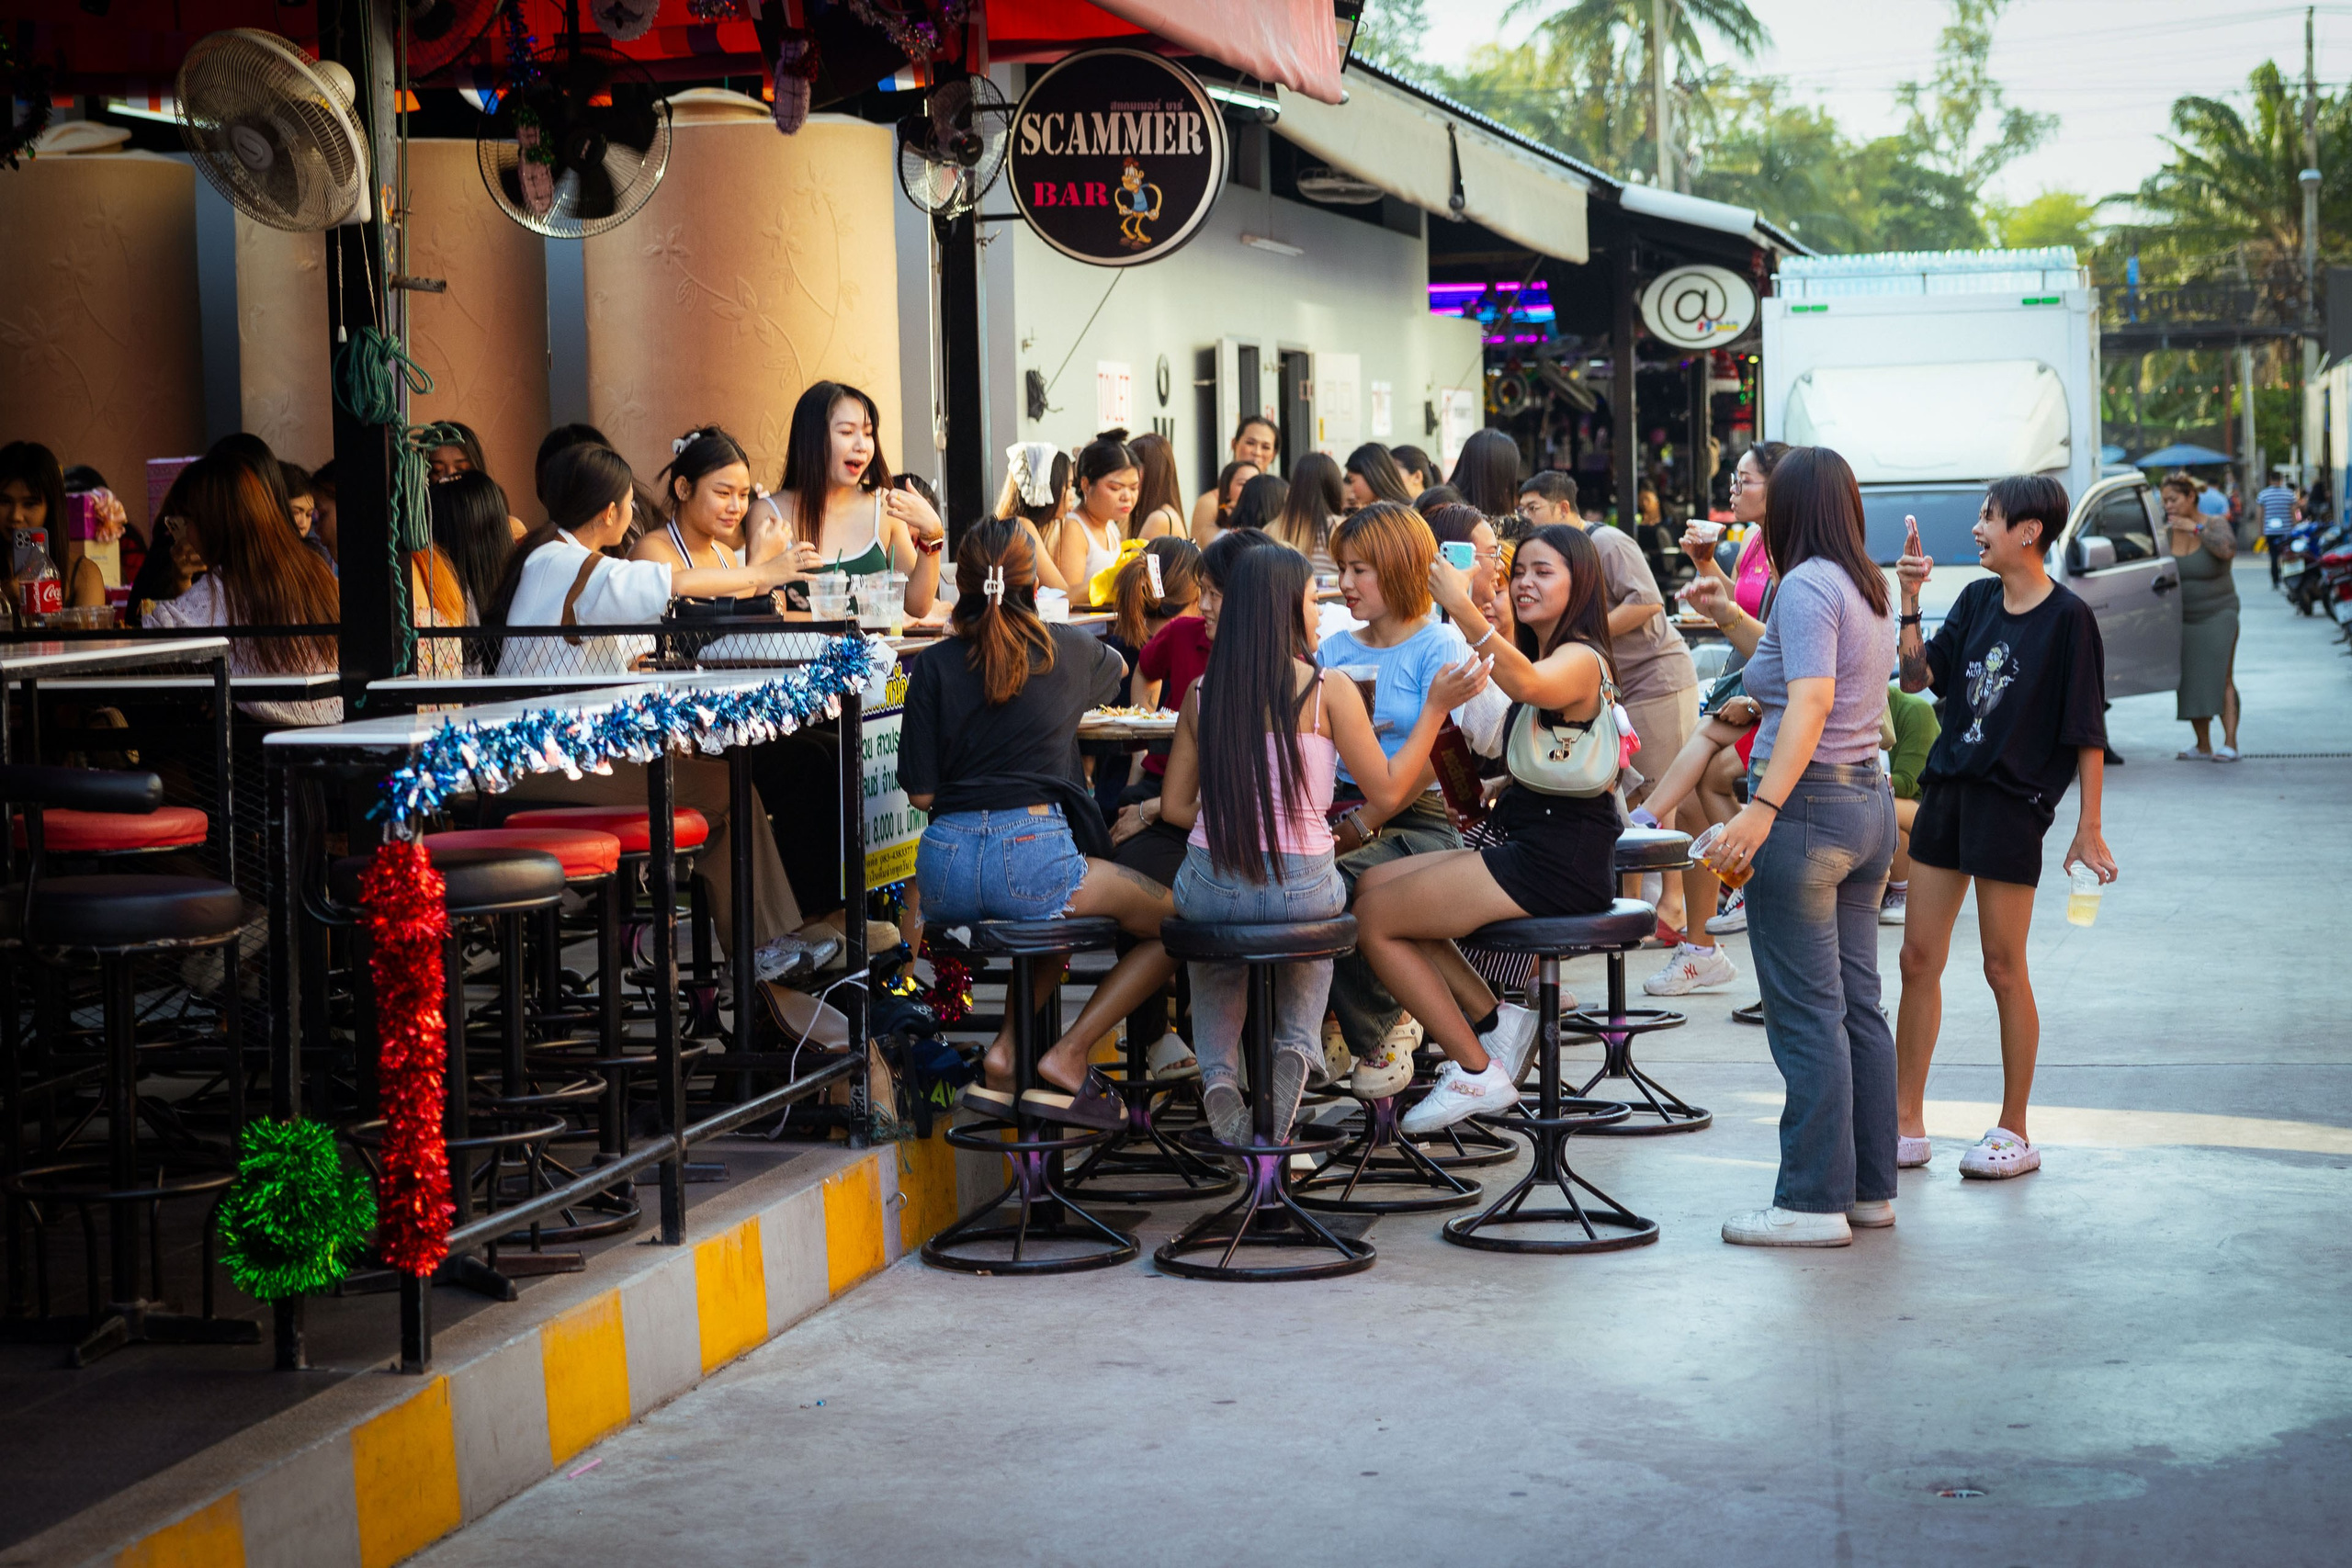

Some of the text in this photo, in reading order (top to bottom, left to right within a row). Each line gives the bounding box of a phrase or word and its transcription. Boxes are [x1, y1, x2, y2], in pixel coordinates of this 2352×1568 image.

[1020, 111, 1204, 155] SCAMMER
[1032, 181, 1110, 208] BAR
[873, 811, 894, 848] 8,000
